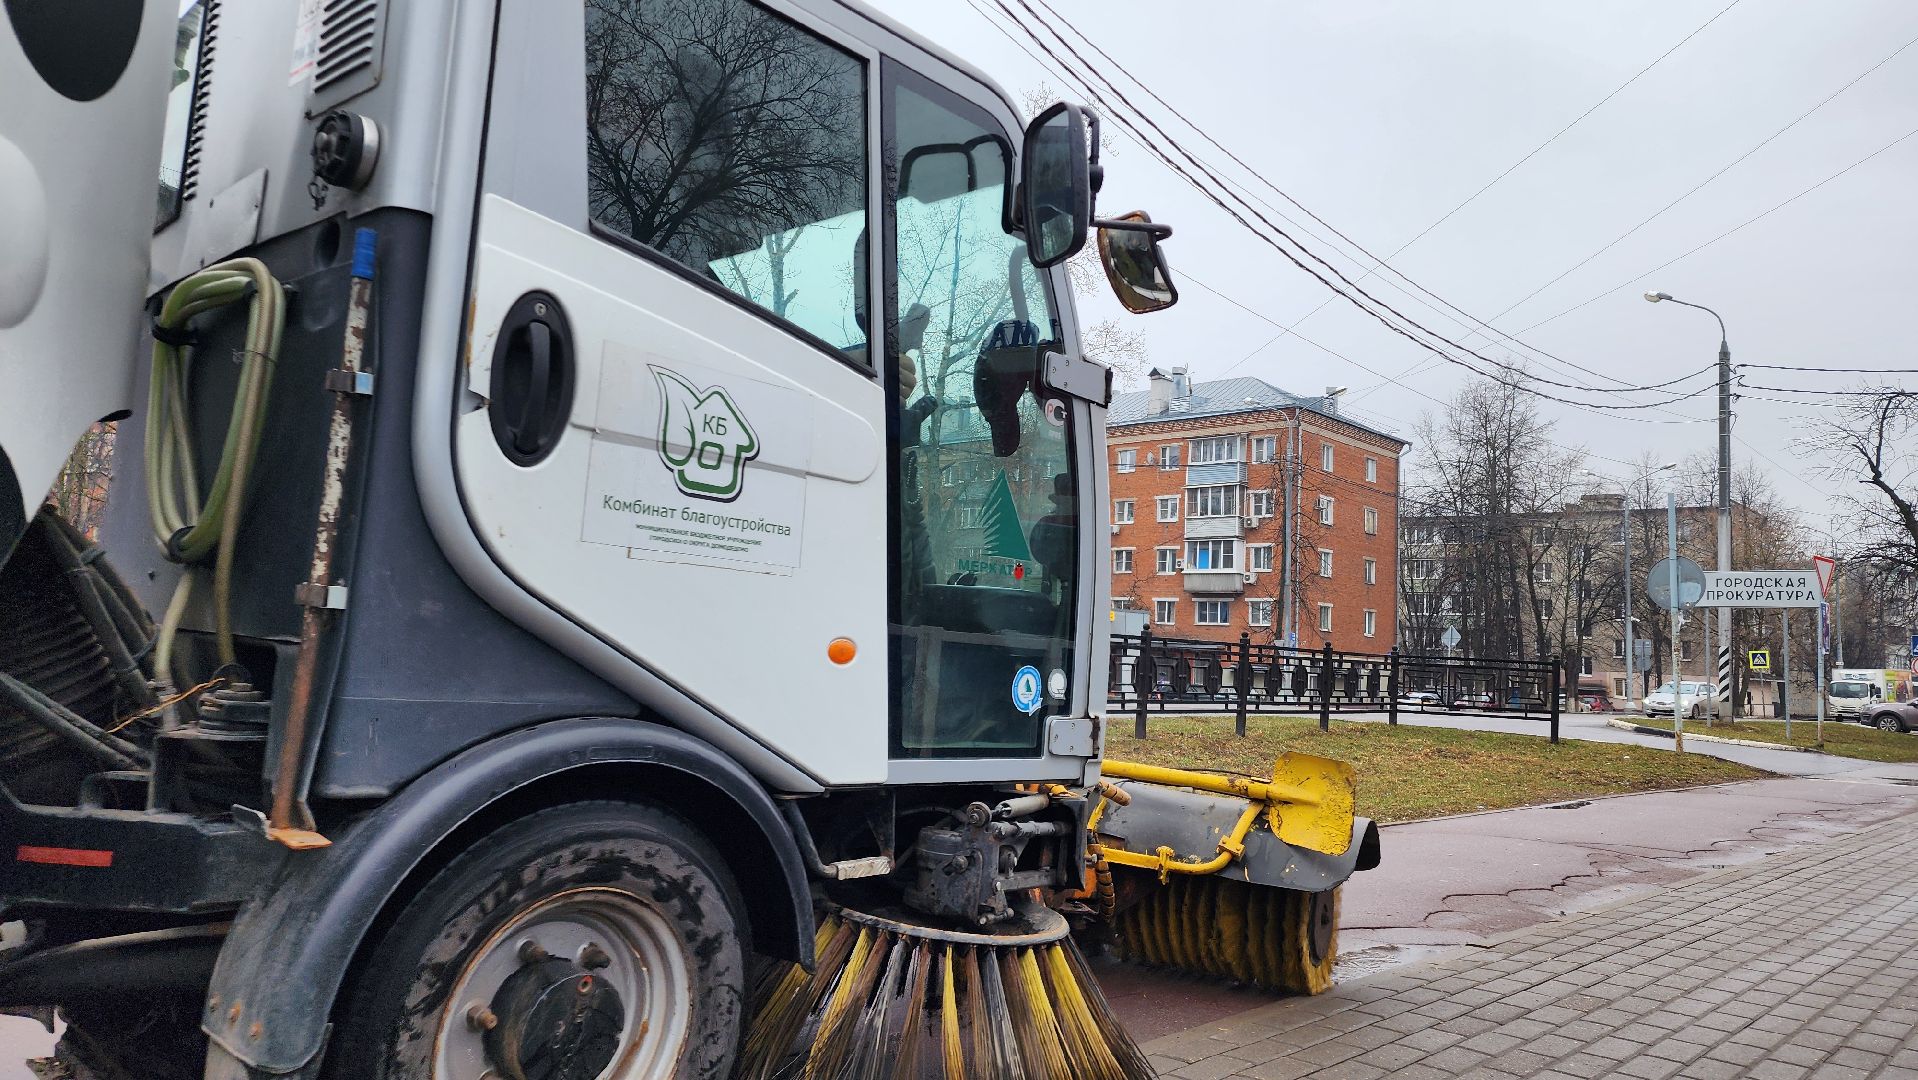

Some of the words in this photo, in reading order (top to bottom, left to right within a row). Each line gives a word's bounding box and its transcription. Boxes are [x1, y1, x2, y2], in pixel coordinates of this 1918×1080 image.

[702, 414, 727, 435] КБ
[602, 495, 677, 519] Комбинат
[681, 507, 791, 536] благоустройства
[958, 559, 1033, 577] МЕРКАТР
[1716, 577, 1806, 589] ГОРОДСКАЯ
[1707, 590, 1815, 601] ПРОКУРАТУРА
